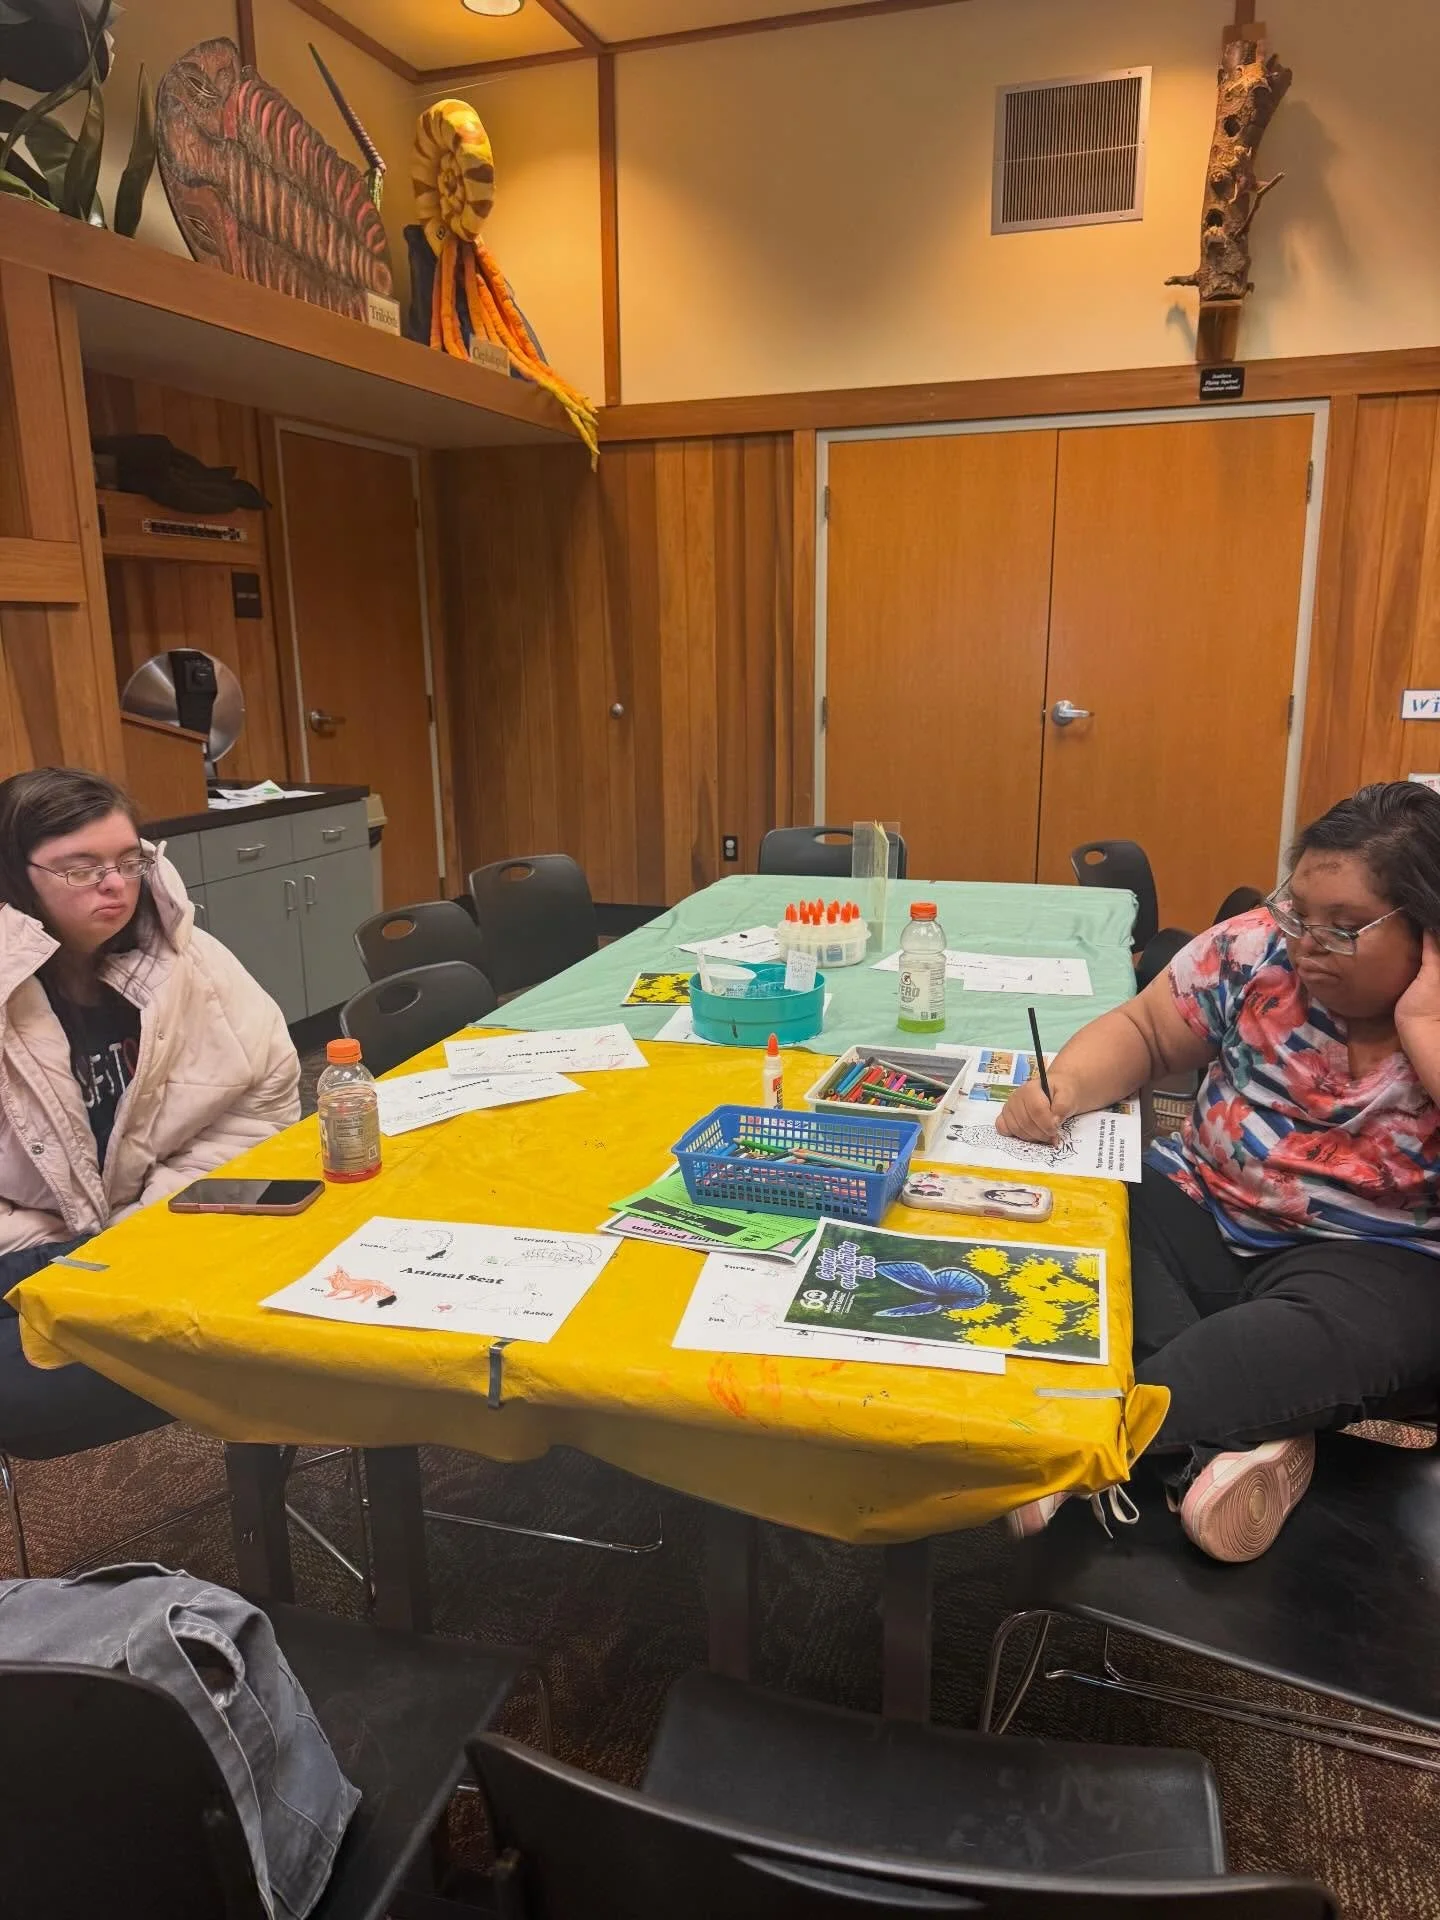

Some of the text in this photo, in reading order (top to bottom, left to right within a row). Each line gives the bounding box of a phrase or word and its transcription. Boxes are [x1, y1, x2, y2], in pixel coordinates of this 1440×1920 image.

[400, 1267, 505, 1285] Animal Scat
[522, 1309, 554, 1318] Rabbit
